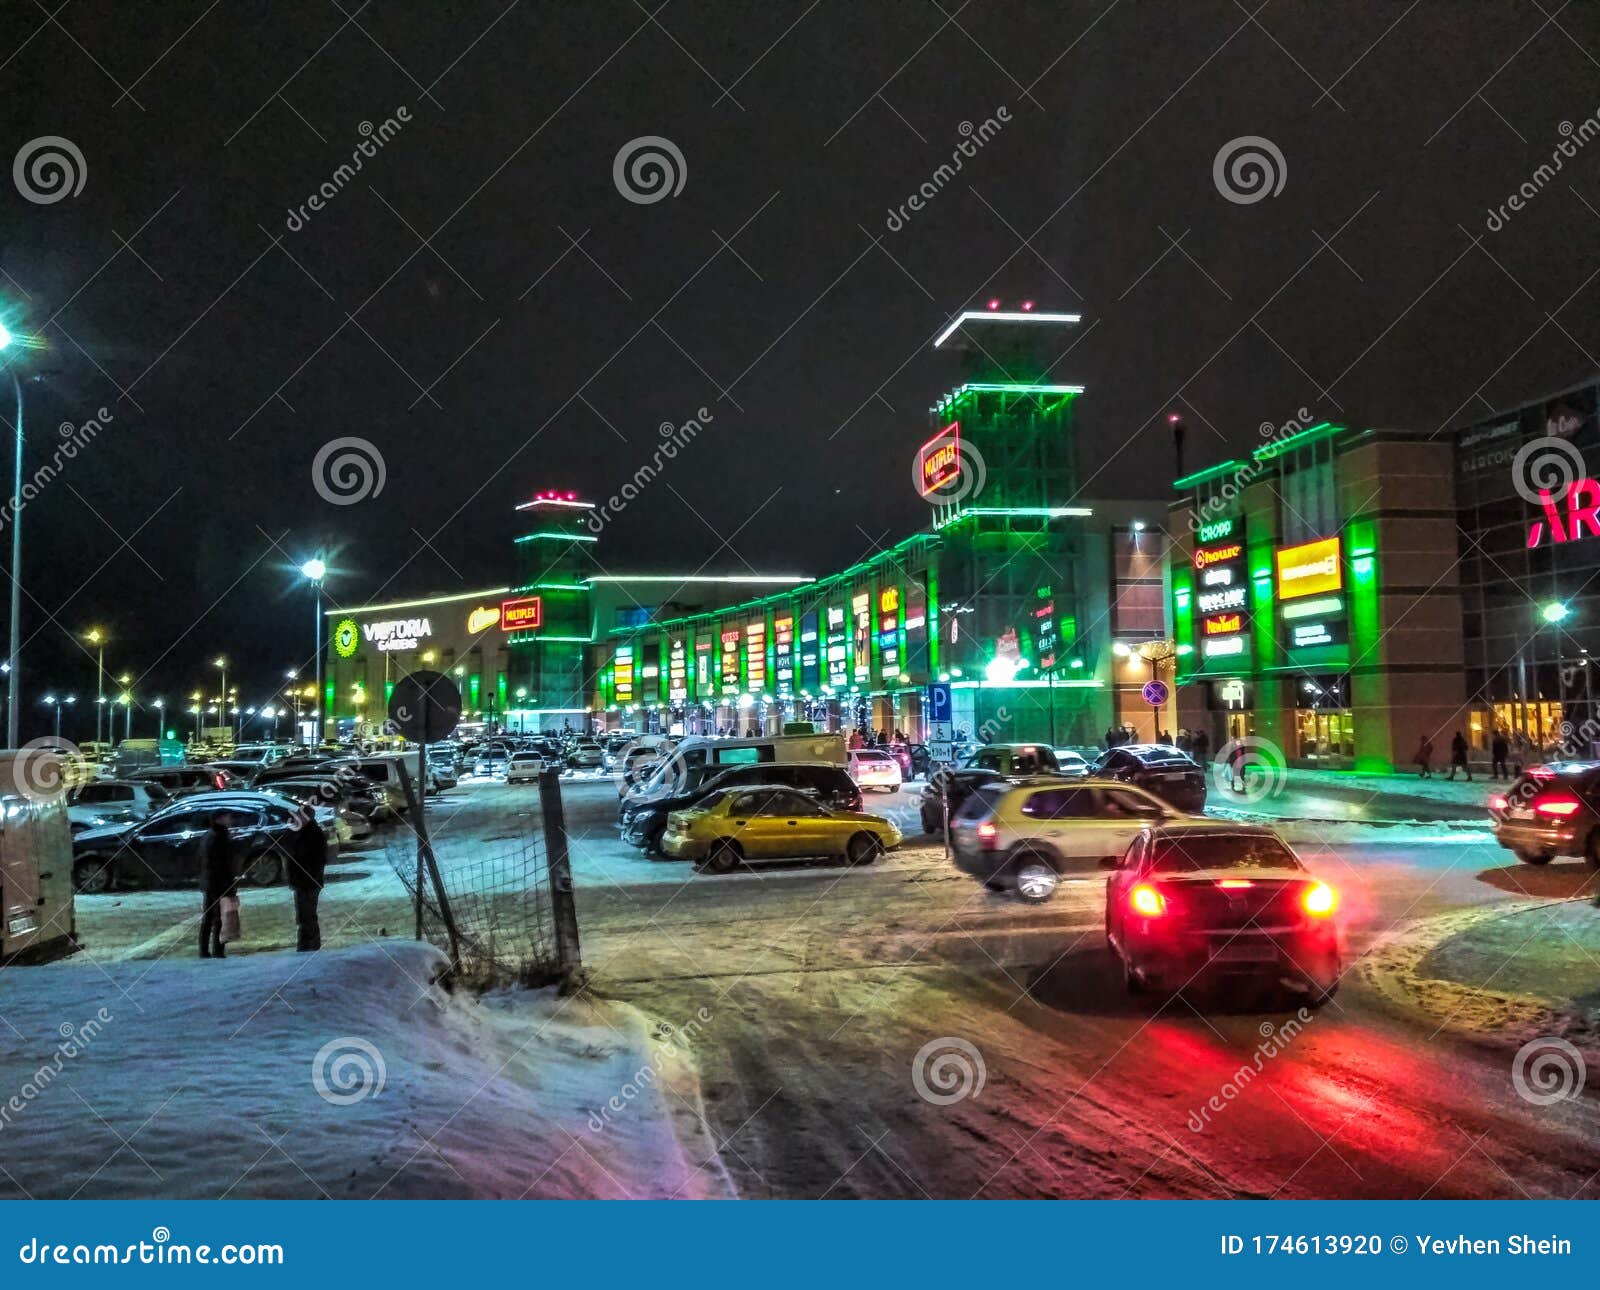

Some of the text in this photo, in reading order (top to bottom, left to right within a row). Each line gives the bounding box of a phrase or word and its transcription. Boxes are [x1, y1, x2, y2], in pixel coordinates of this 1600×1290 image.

[1200, 520, 1232, 542] CROPP
[505, 606, 537, 622] MULTIPLEX
[721, 630, 739, 643] GUESS
[933, 687, 947, 718] P
